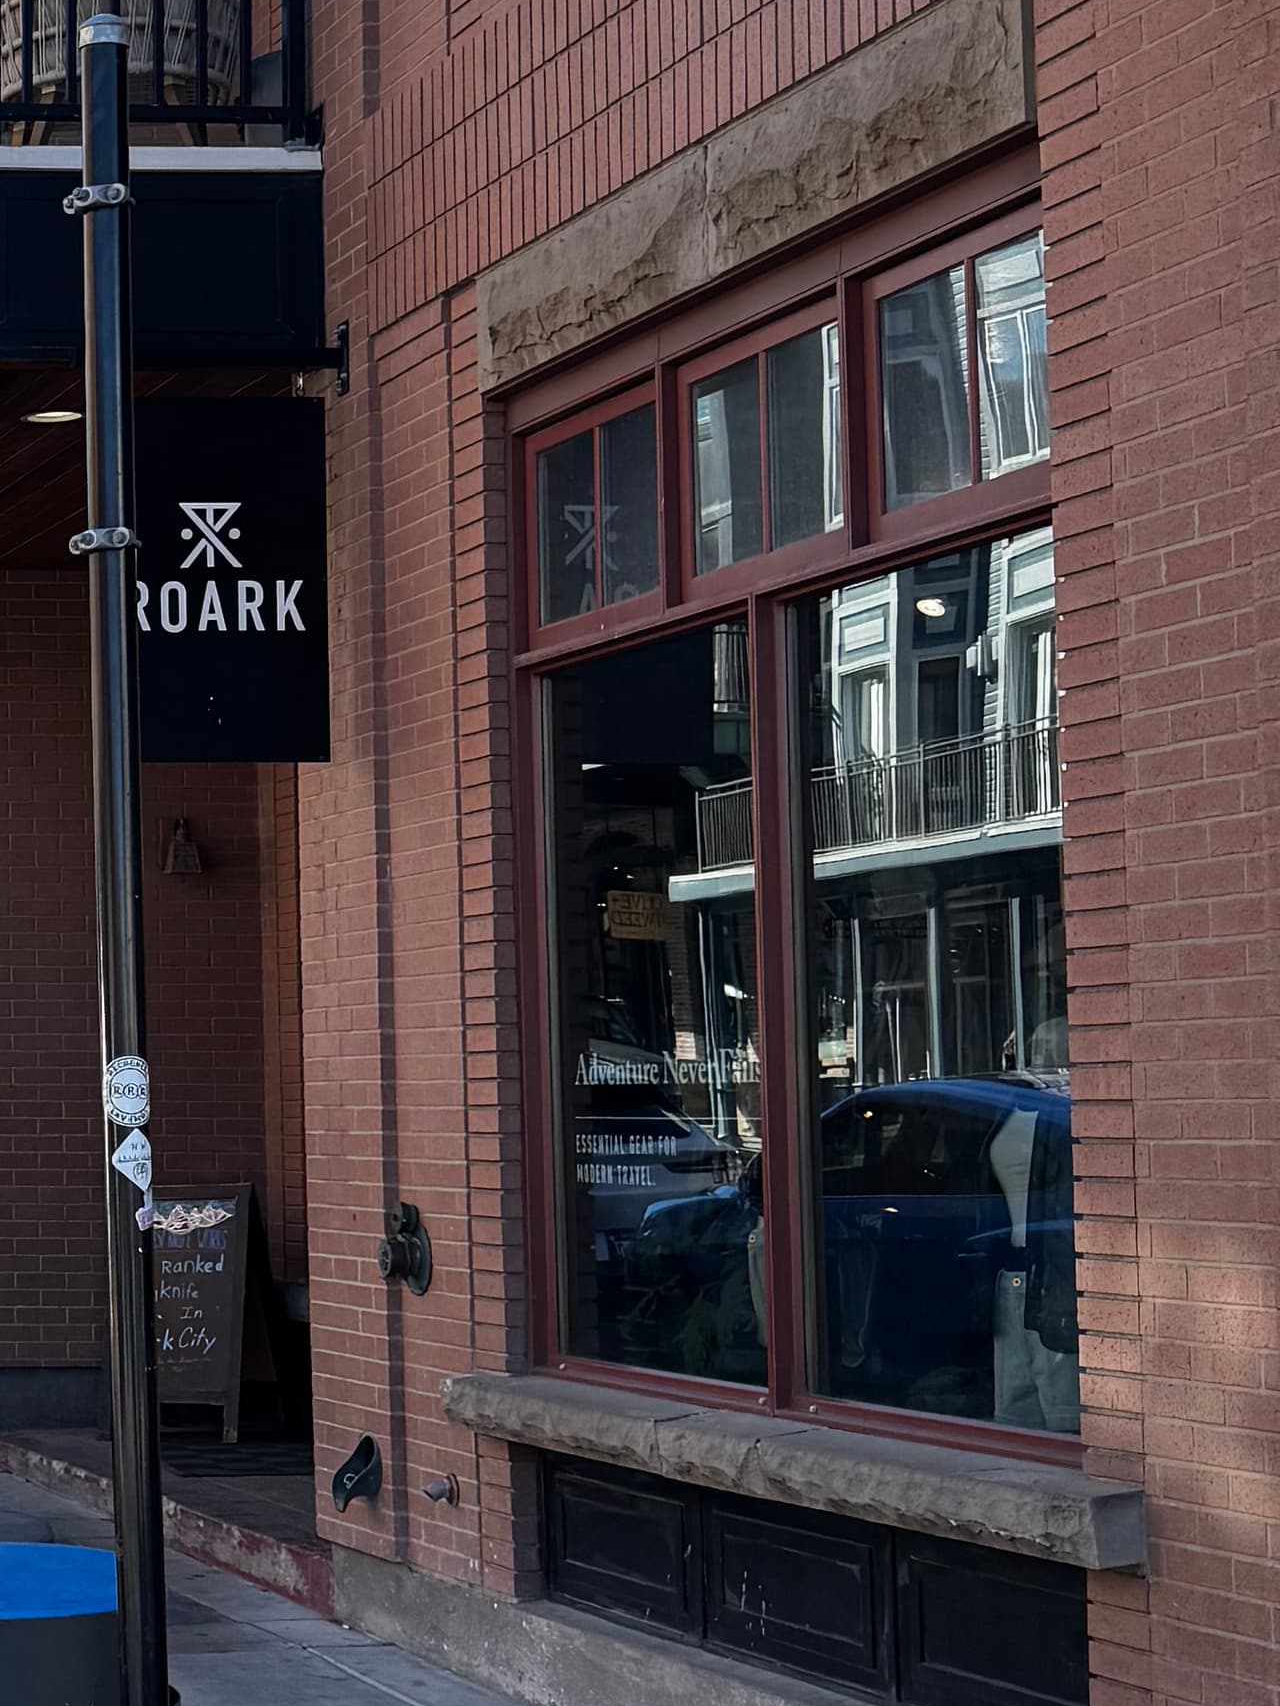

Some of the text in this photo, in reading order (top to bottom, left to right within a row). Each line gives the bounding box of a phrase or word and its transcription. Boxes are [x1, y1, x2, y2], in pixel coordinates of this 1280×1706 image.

[136, 580, 307, 634] ROARK
[575, 1053, 659, 1086] Adventure
[662, 1050, 714, 1086] Never
[576, 1134, 677, 1156] ESSENTIAL GEAR FOR
[576, 1163, 656, 1186] MODERN TRAVEL.
[162, 1254, 224, 1274] Ranked
[178, 1327, 216, 1354] City
